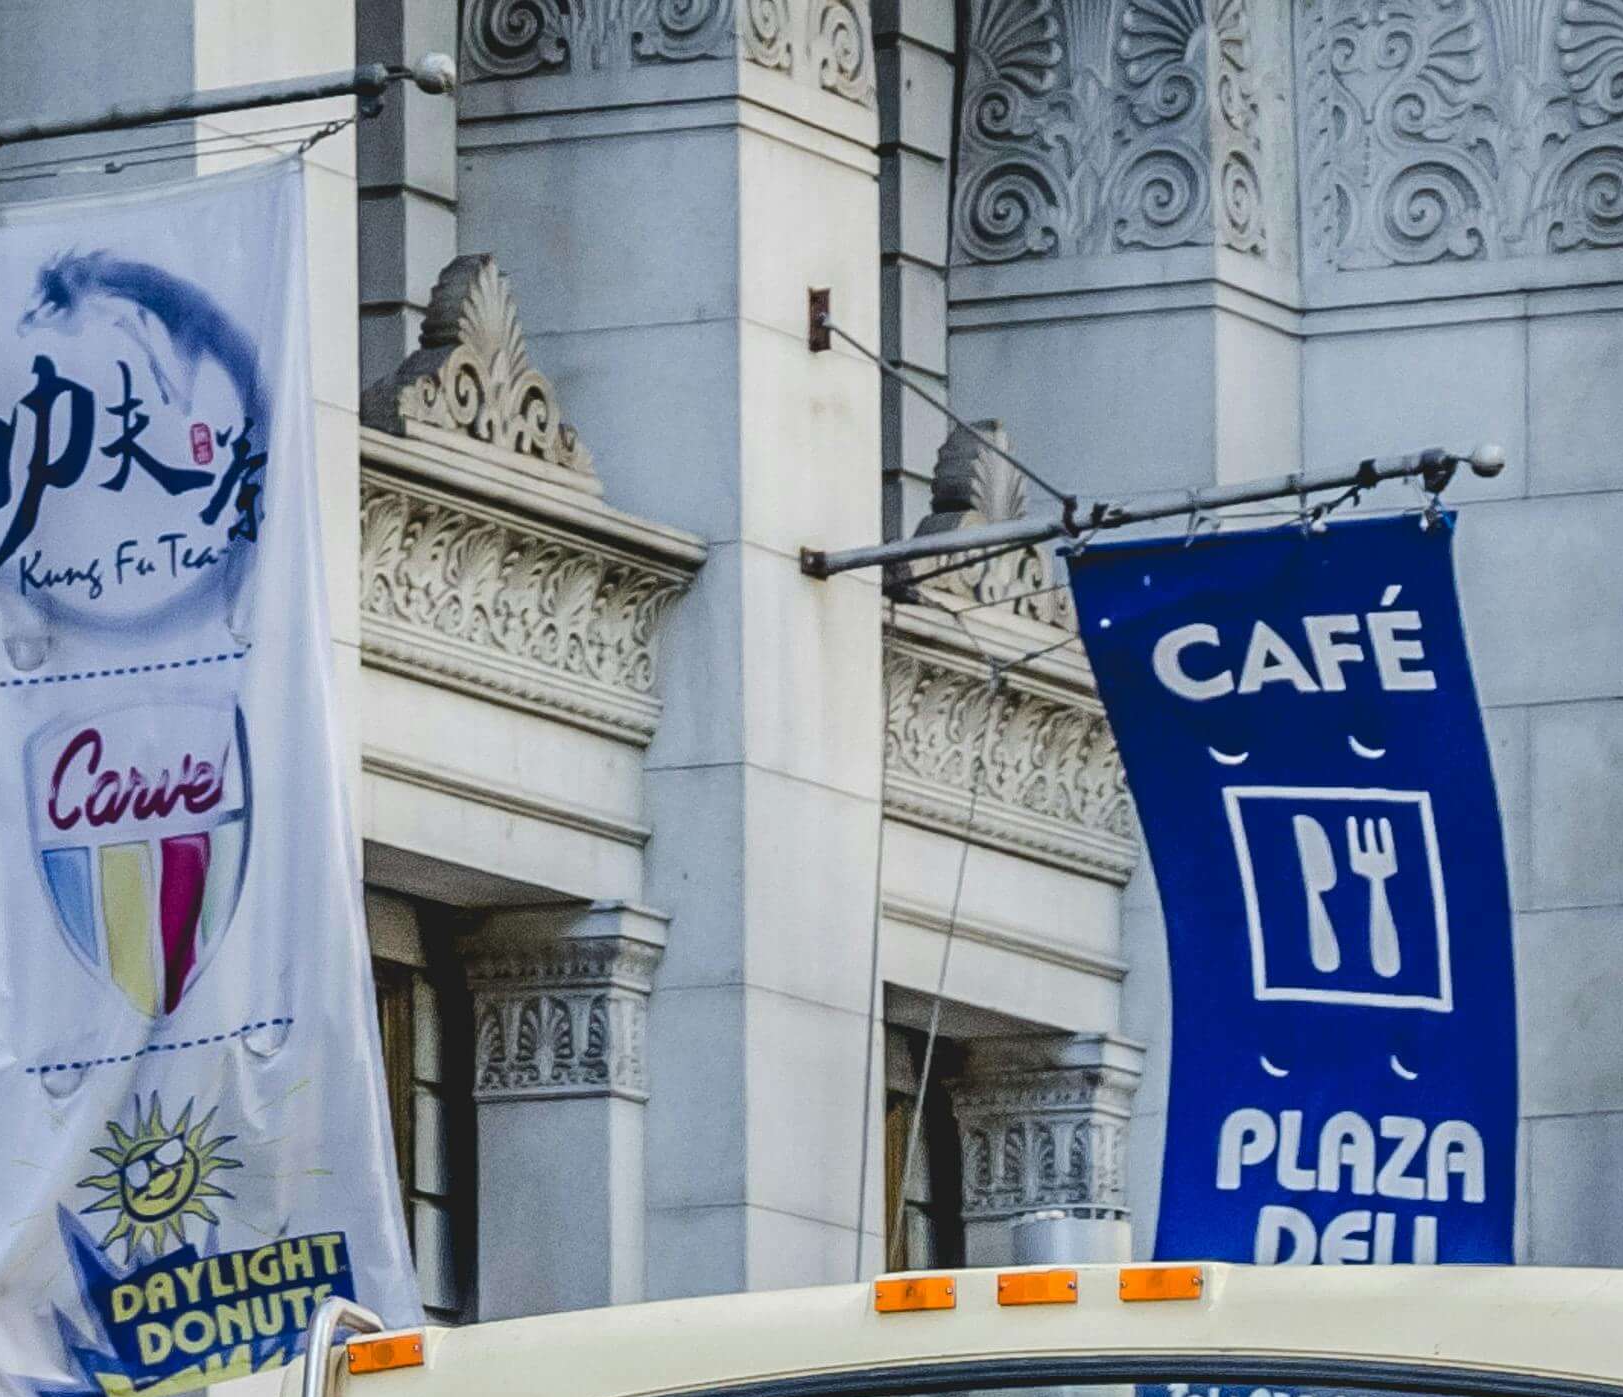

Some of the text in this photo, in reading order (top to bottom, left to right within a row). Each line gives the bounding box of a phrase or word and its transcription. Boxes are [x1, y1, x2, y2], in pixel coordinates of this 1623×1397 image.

[19, 550, 102, 599] Kung
[115, 540, 156, 584] Fu
[1153, 586, 1437, 701] CAFÉ
[1215, 1108, 1485, 1203] PLAZA
[111, 1231, 342, 1323] DAYLIGHT
